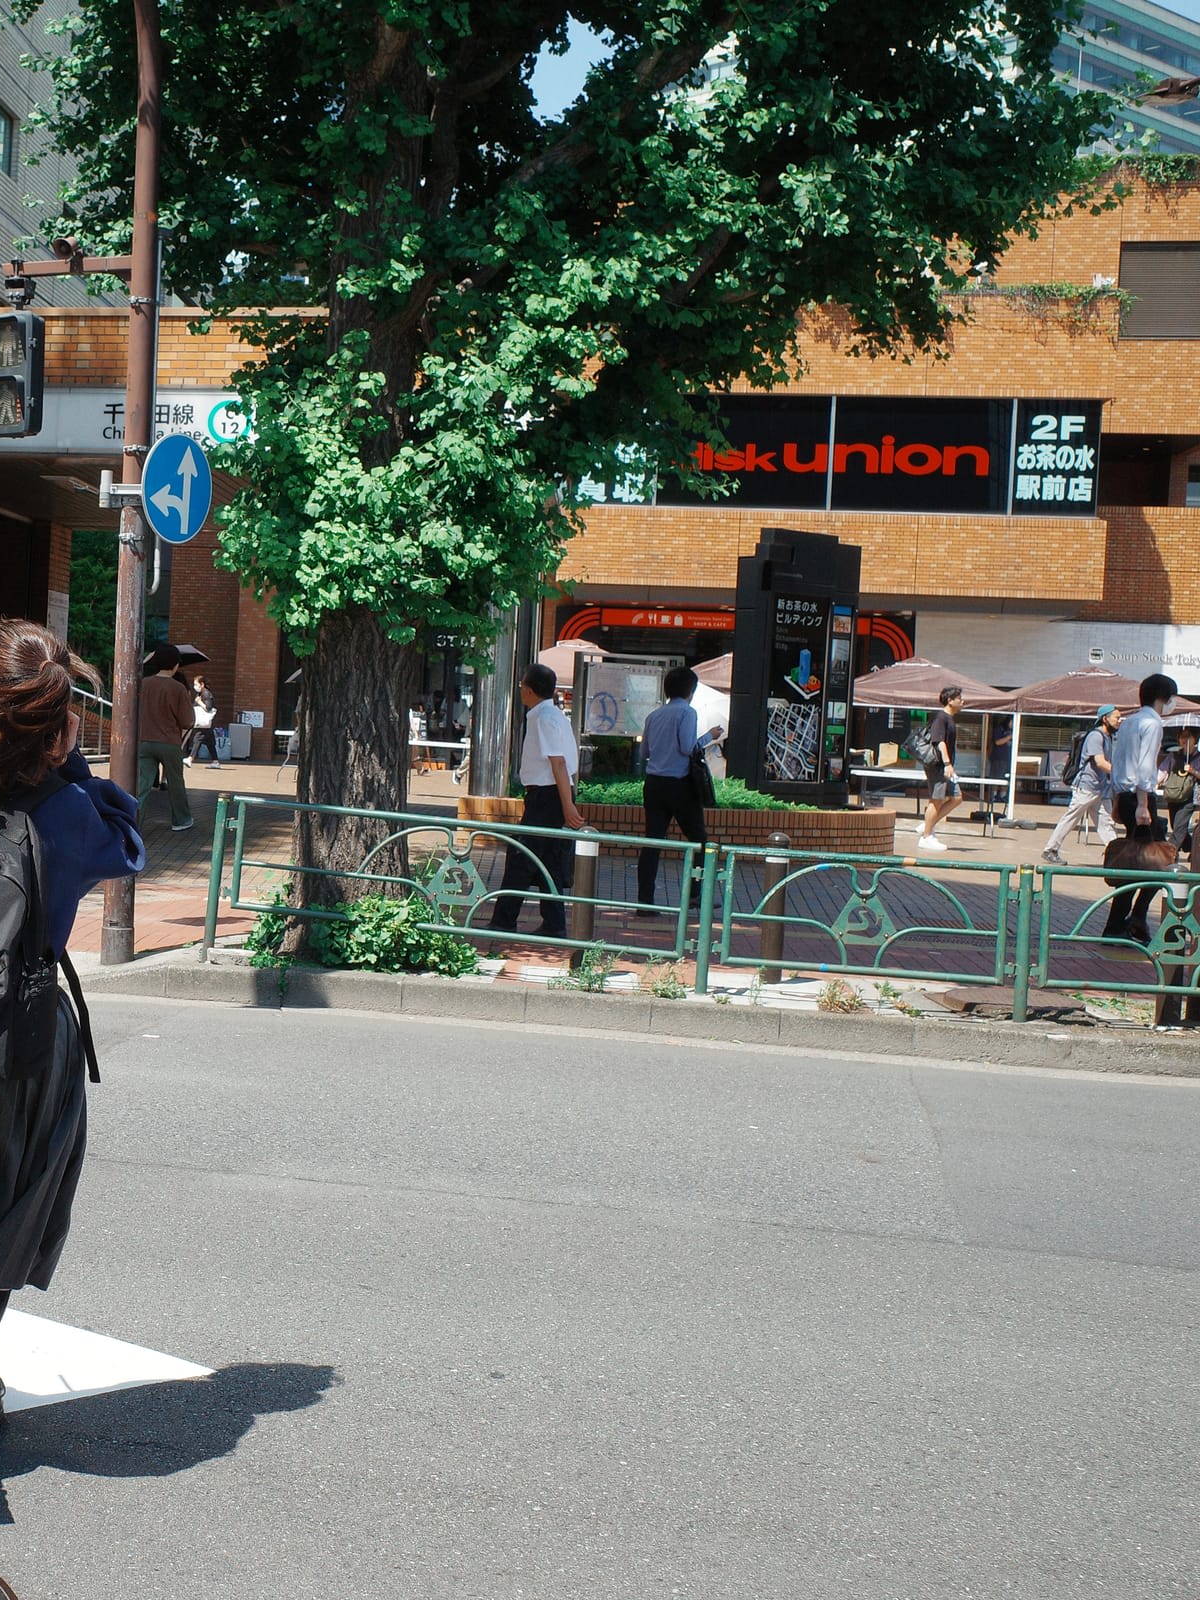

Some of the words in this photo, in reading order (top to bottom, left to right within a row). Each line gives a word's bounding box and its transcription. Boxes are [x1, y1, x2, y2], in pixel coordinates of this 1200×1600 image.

[103, 403, 194, 425] 千田線
[102, 425, 165, 440] Chia
[221, 422, 240, 434] 12
[1030, 414, 1086, 441] 2F
[784, 435, 990, 477] union
[1016, 444, 1096, 472] お茶の水
[1016, 474, 1094, 502] 駅前店
[776, 612, 824, 627] ビルディング
[1110, 651, 1138, 664] Soup
[1142, 651, 1174, 665] Stock
